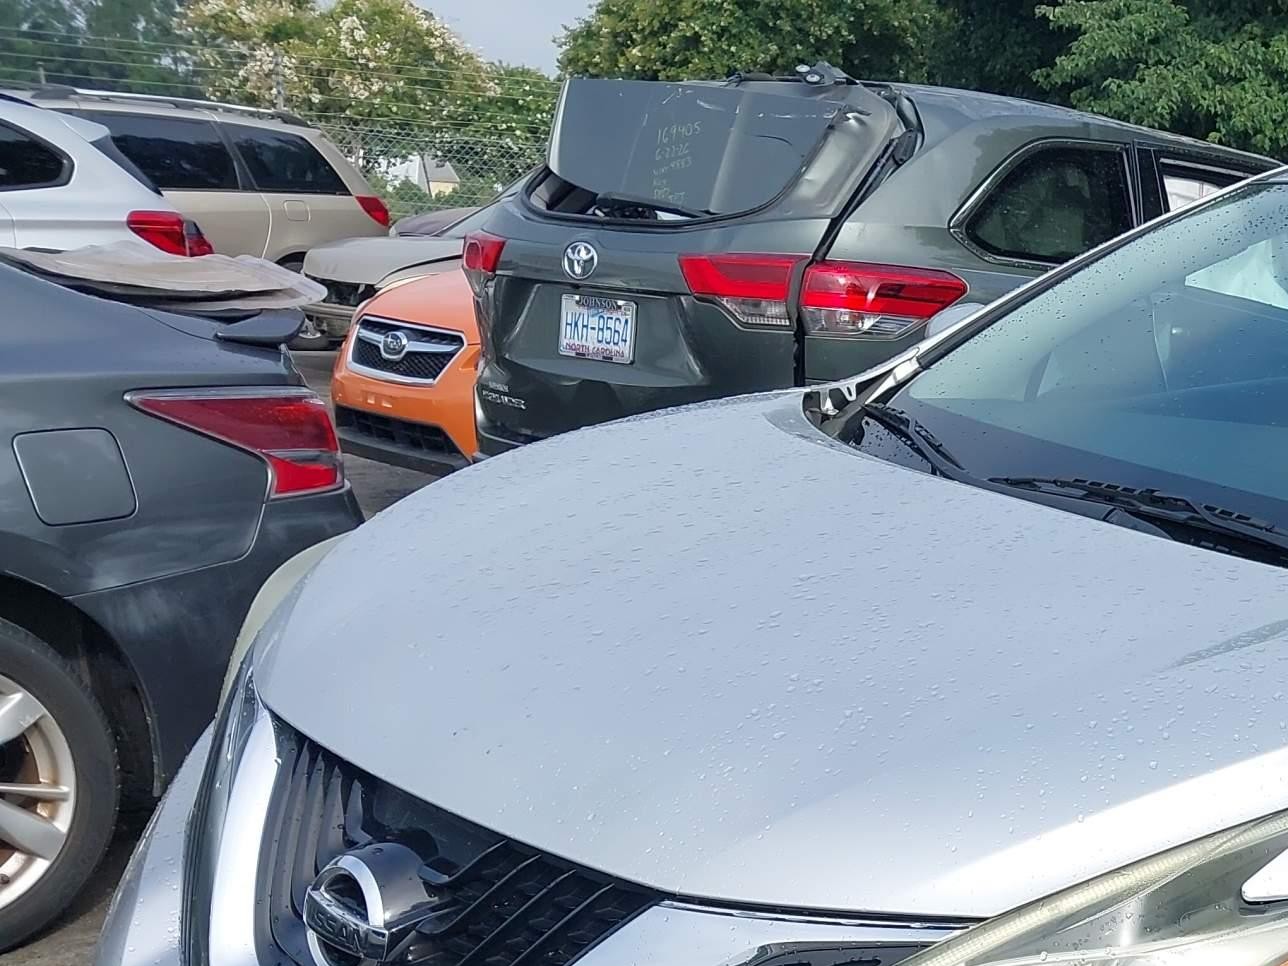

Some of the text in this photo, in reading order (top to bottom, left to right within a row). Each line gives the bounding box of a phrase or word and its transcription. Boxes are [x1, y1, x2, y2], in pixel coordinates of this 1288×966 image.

[579, 296, 617, 310] JOHNSON
[564, 311, 629, 346] HKH-8564
[565, 342, 590, 353] NORTH
[591, 346, 625, 358] CAROLINA
